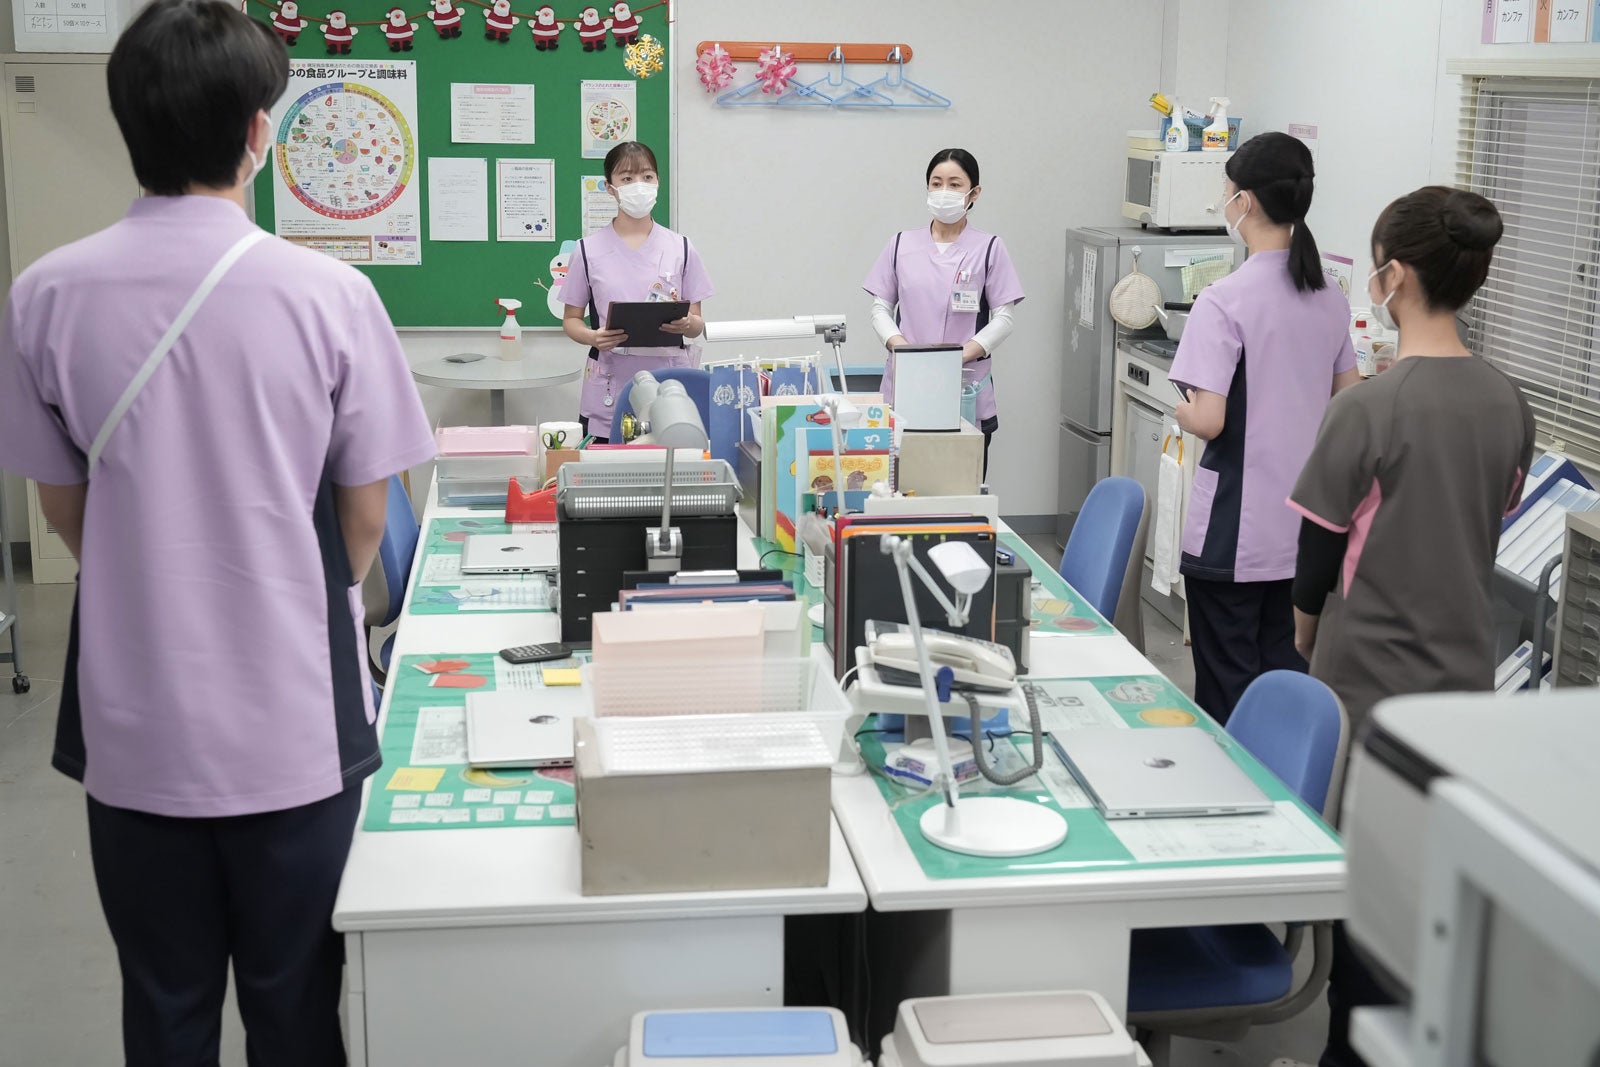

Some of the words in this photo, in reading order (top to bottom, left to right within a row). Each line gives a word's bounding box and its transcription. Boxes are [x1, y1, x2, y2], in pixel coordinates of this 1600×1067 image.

[1501, 11, 1523, 23] カンファ
[1556, 9, 1580, 21] カンファ
